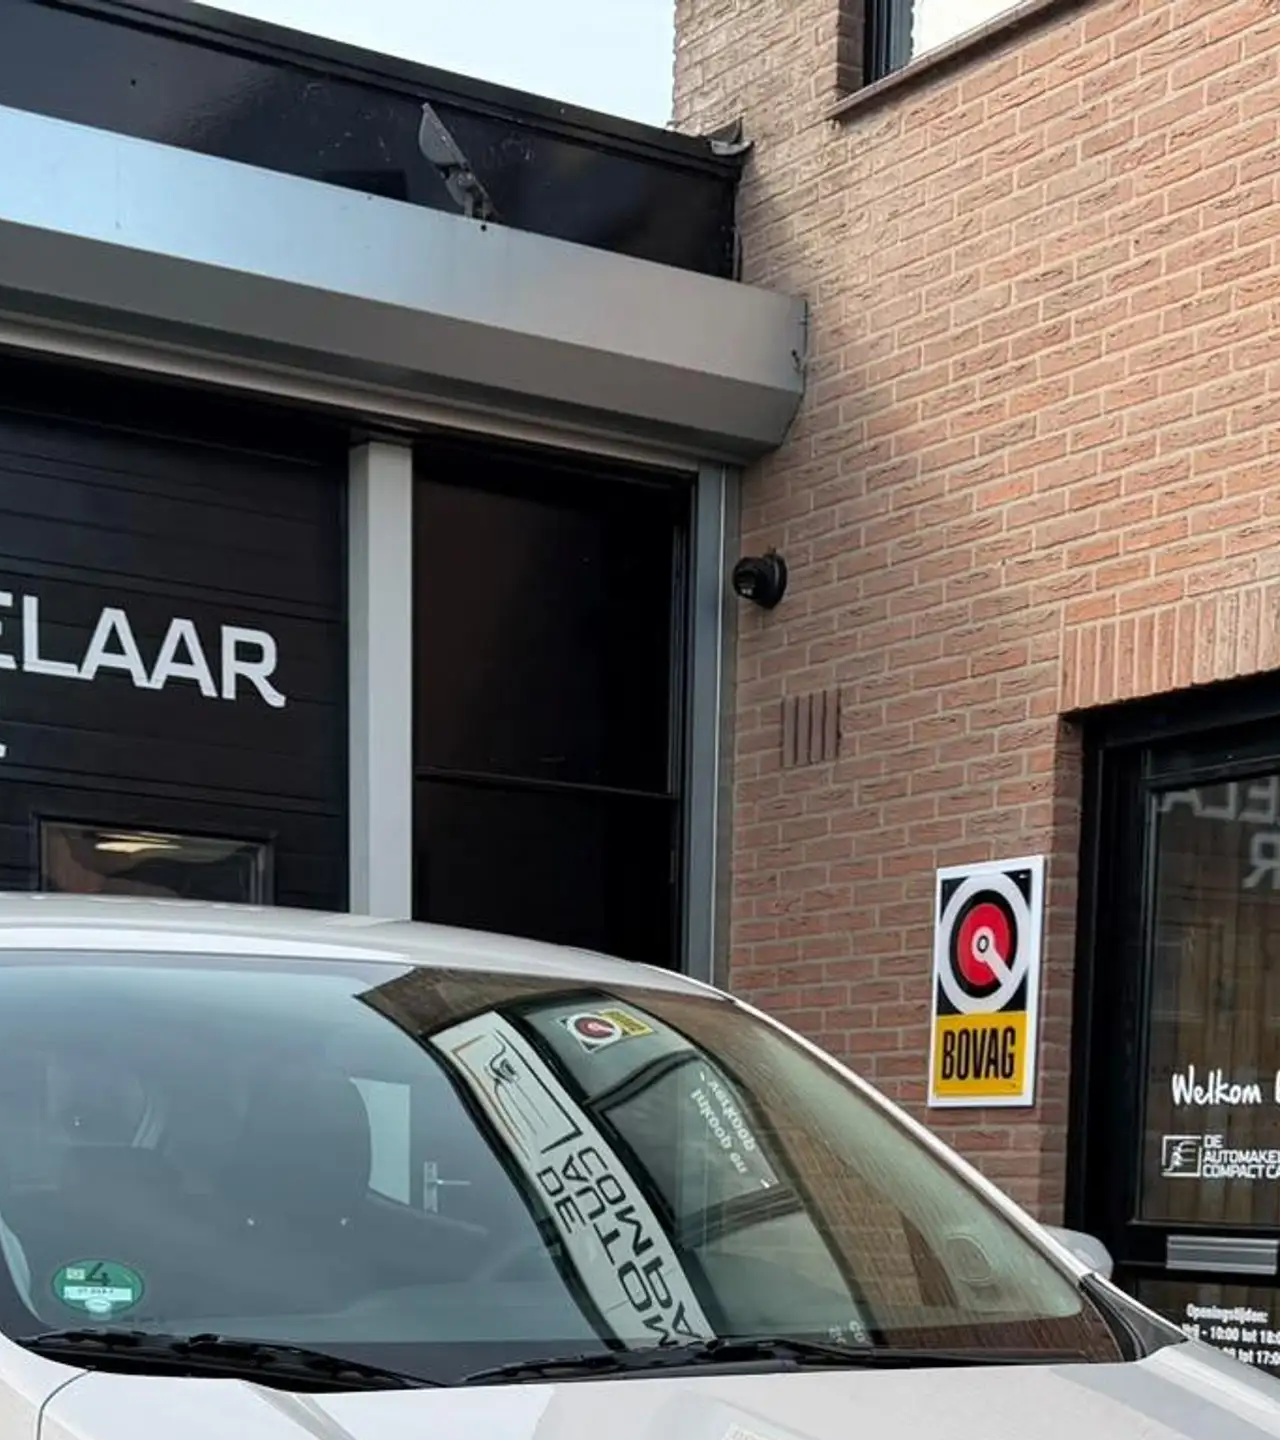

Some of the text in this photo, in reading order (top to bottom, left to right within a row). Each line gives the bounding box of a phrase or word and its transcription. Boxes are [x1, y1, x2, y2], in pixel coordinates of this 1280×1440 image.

[941, 1026, 1016, 1081] BOVAG
[1171, 1064, 1262, 1106] Welkom
[1203, 1134, 1223, 1149] DE
[1202, 1164, 1265, 1179] COMPACT
[85, 1261, 111, 1287] 4
